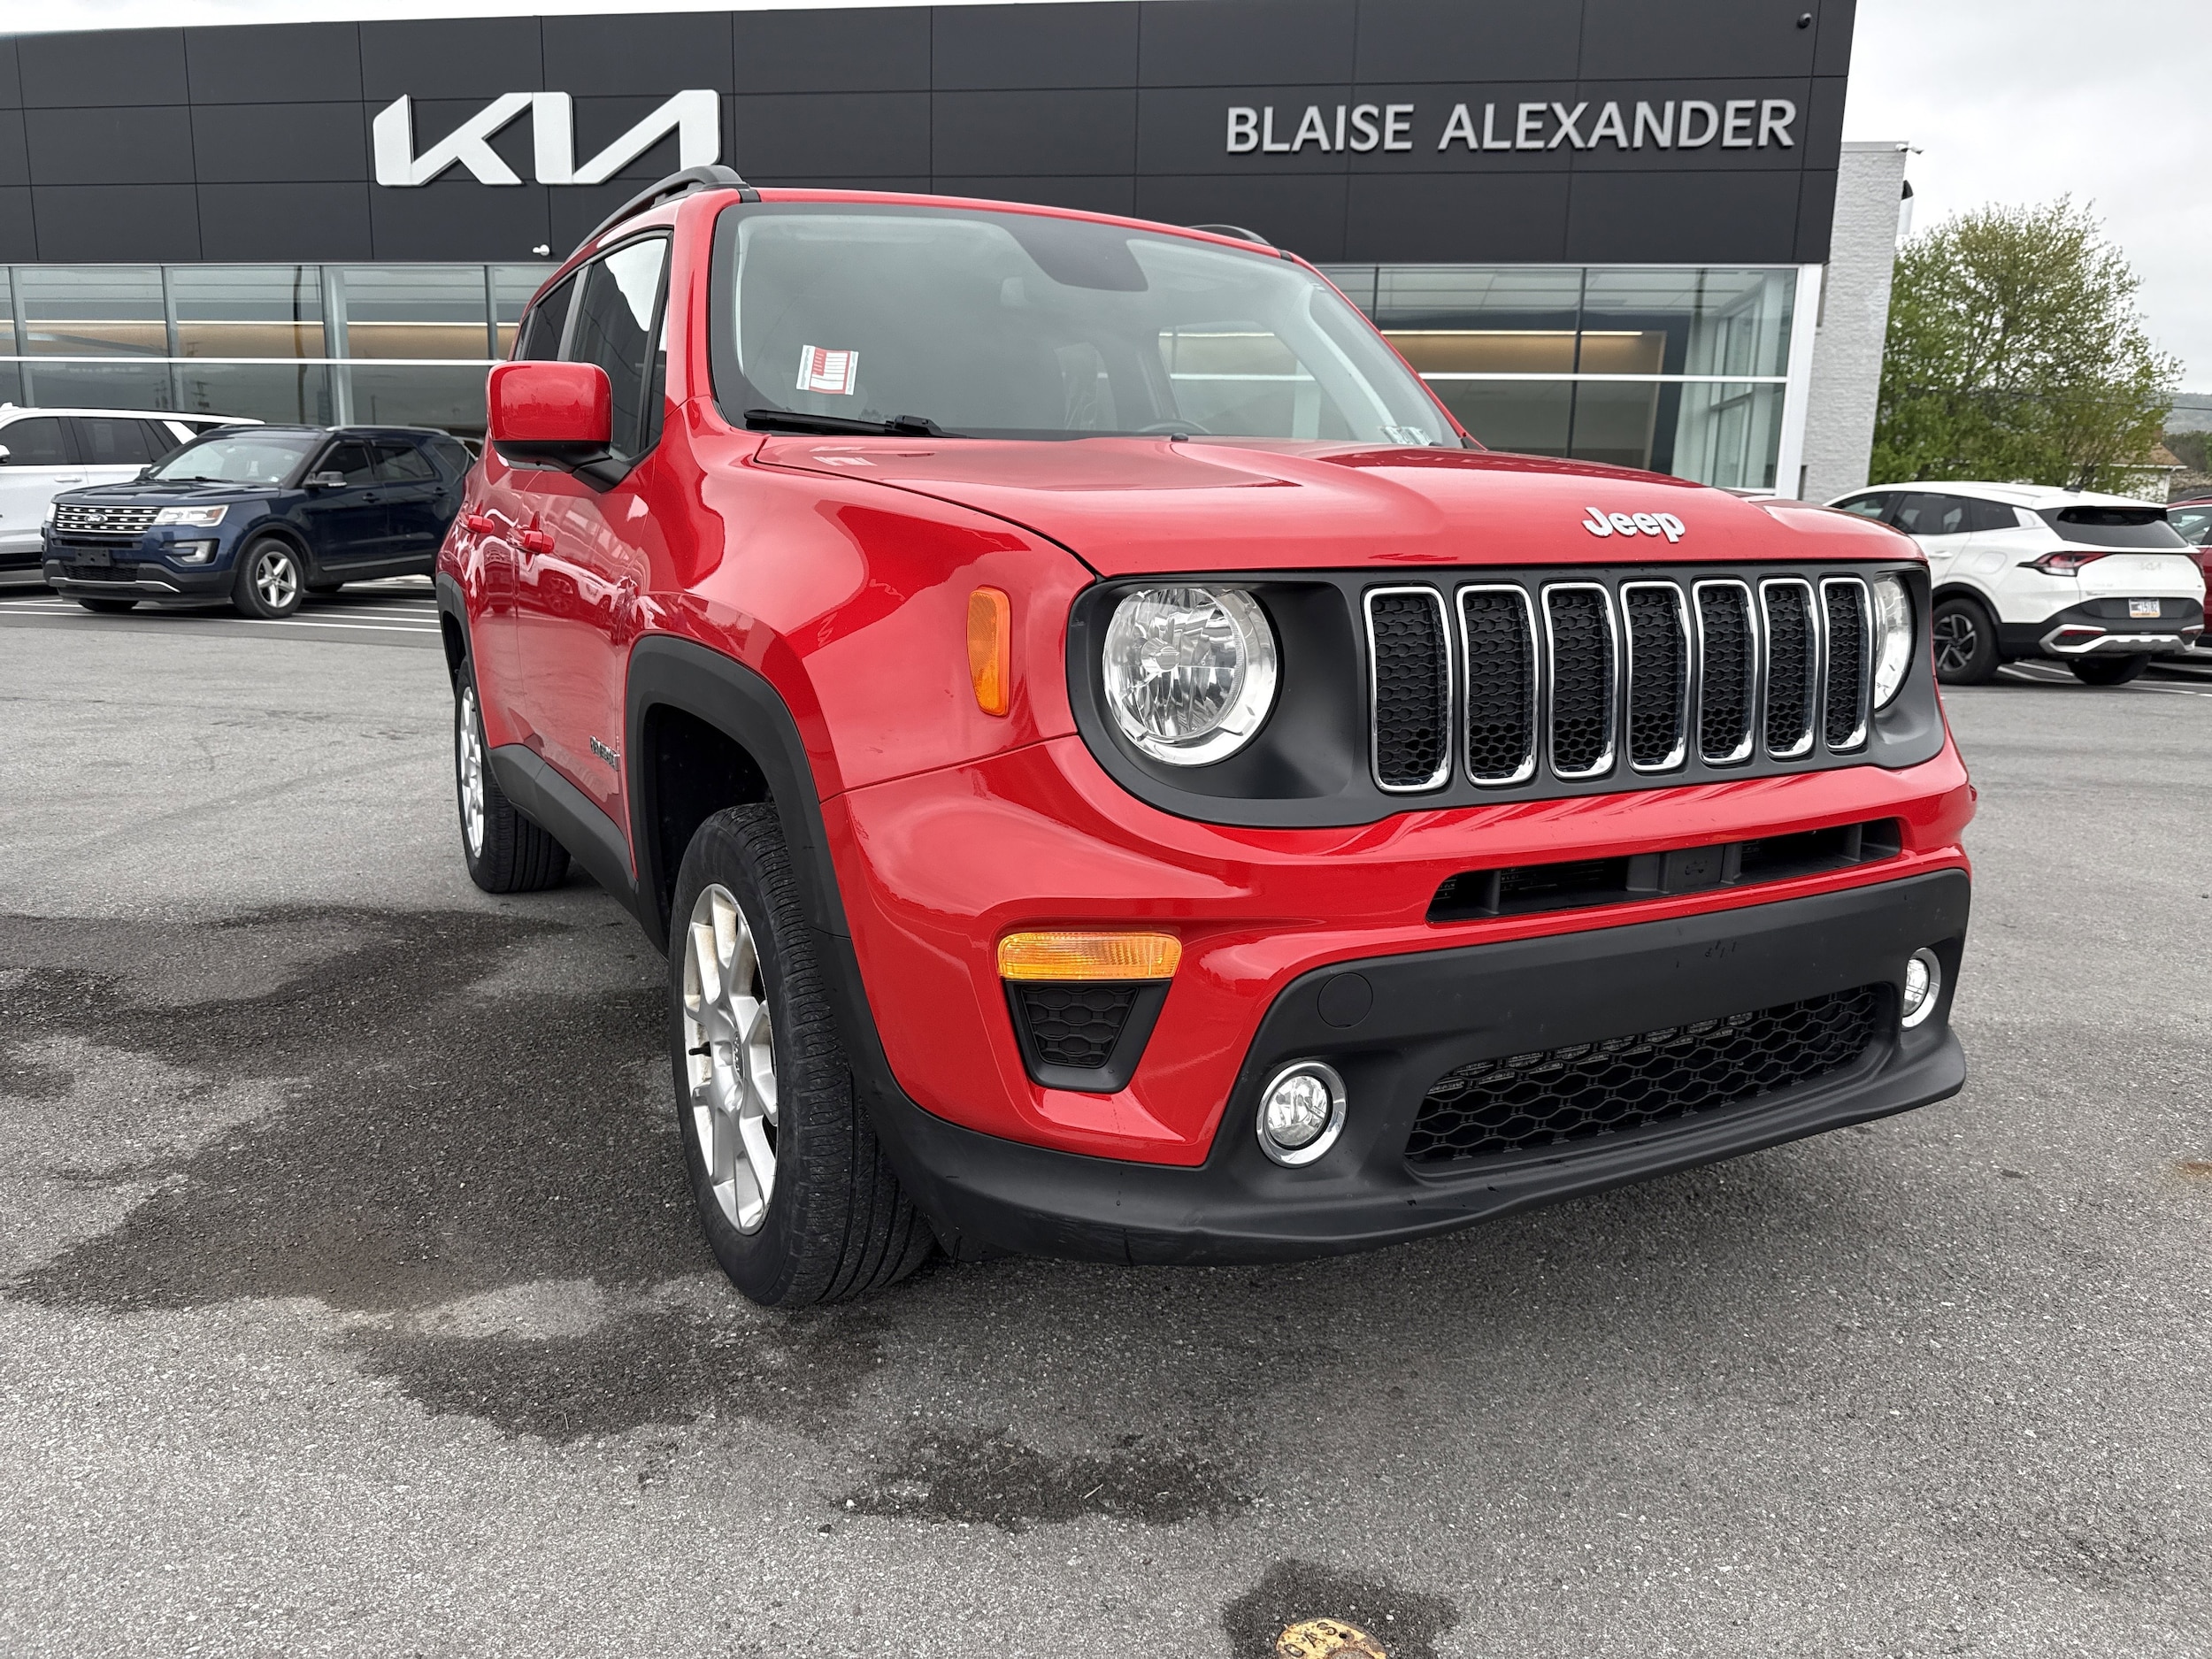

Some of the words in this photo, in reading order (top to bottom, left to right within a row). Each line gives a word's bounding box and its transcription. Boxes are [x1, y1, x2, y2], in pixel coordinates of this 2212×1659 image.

[373, 89, 720, 186] KIA
[1225, 104, 1415, 153] BLAISE
[1437, 98, 1796, 151] ALEXANDER
[1581, 506, 1686, 543] Jeep
